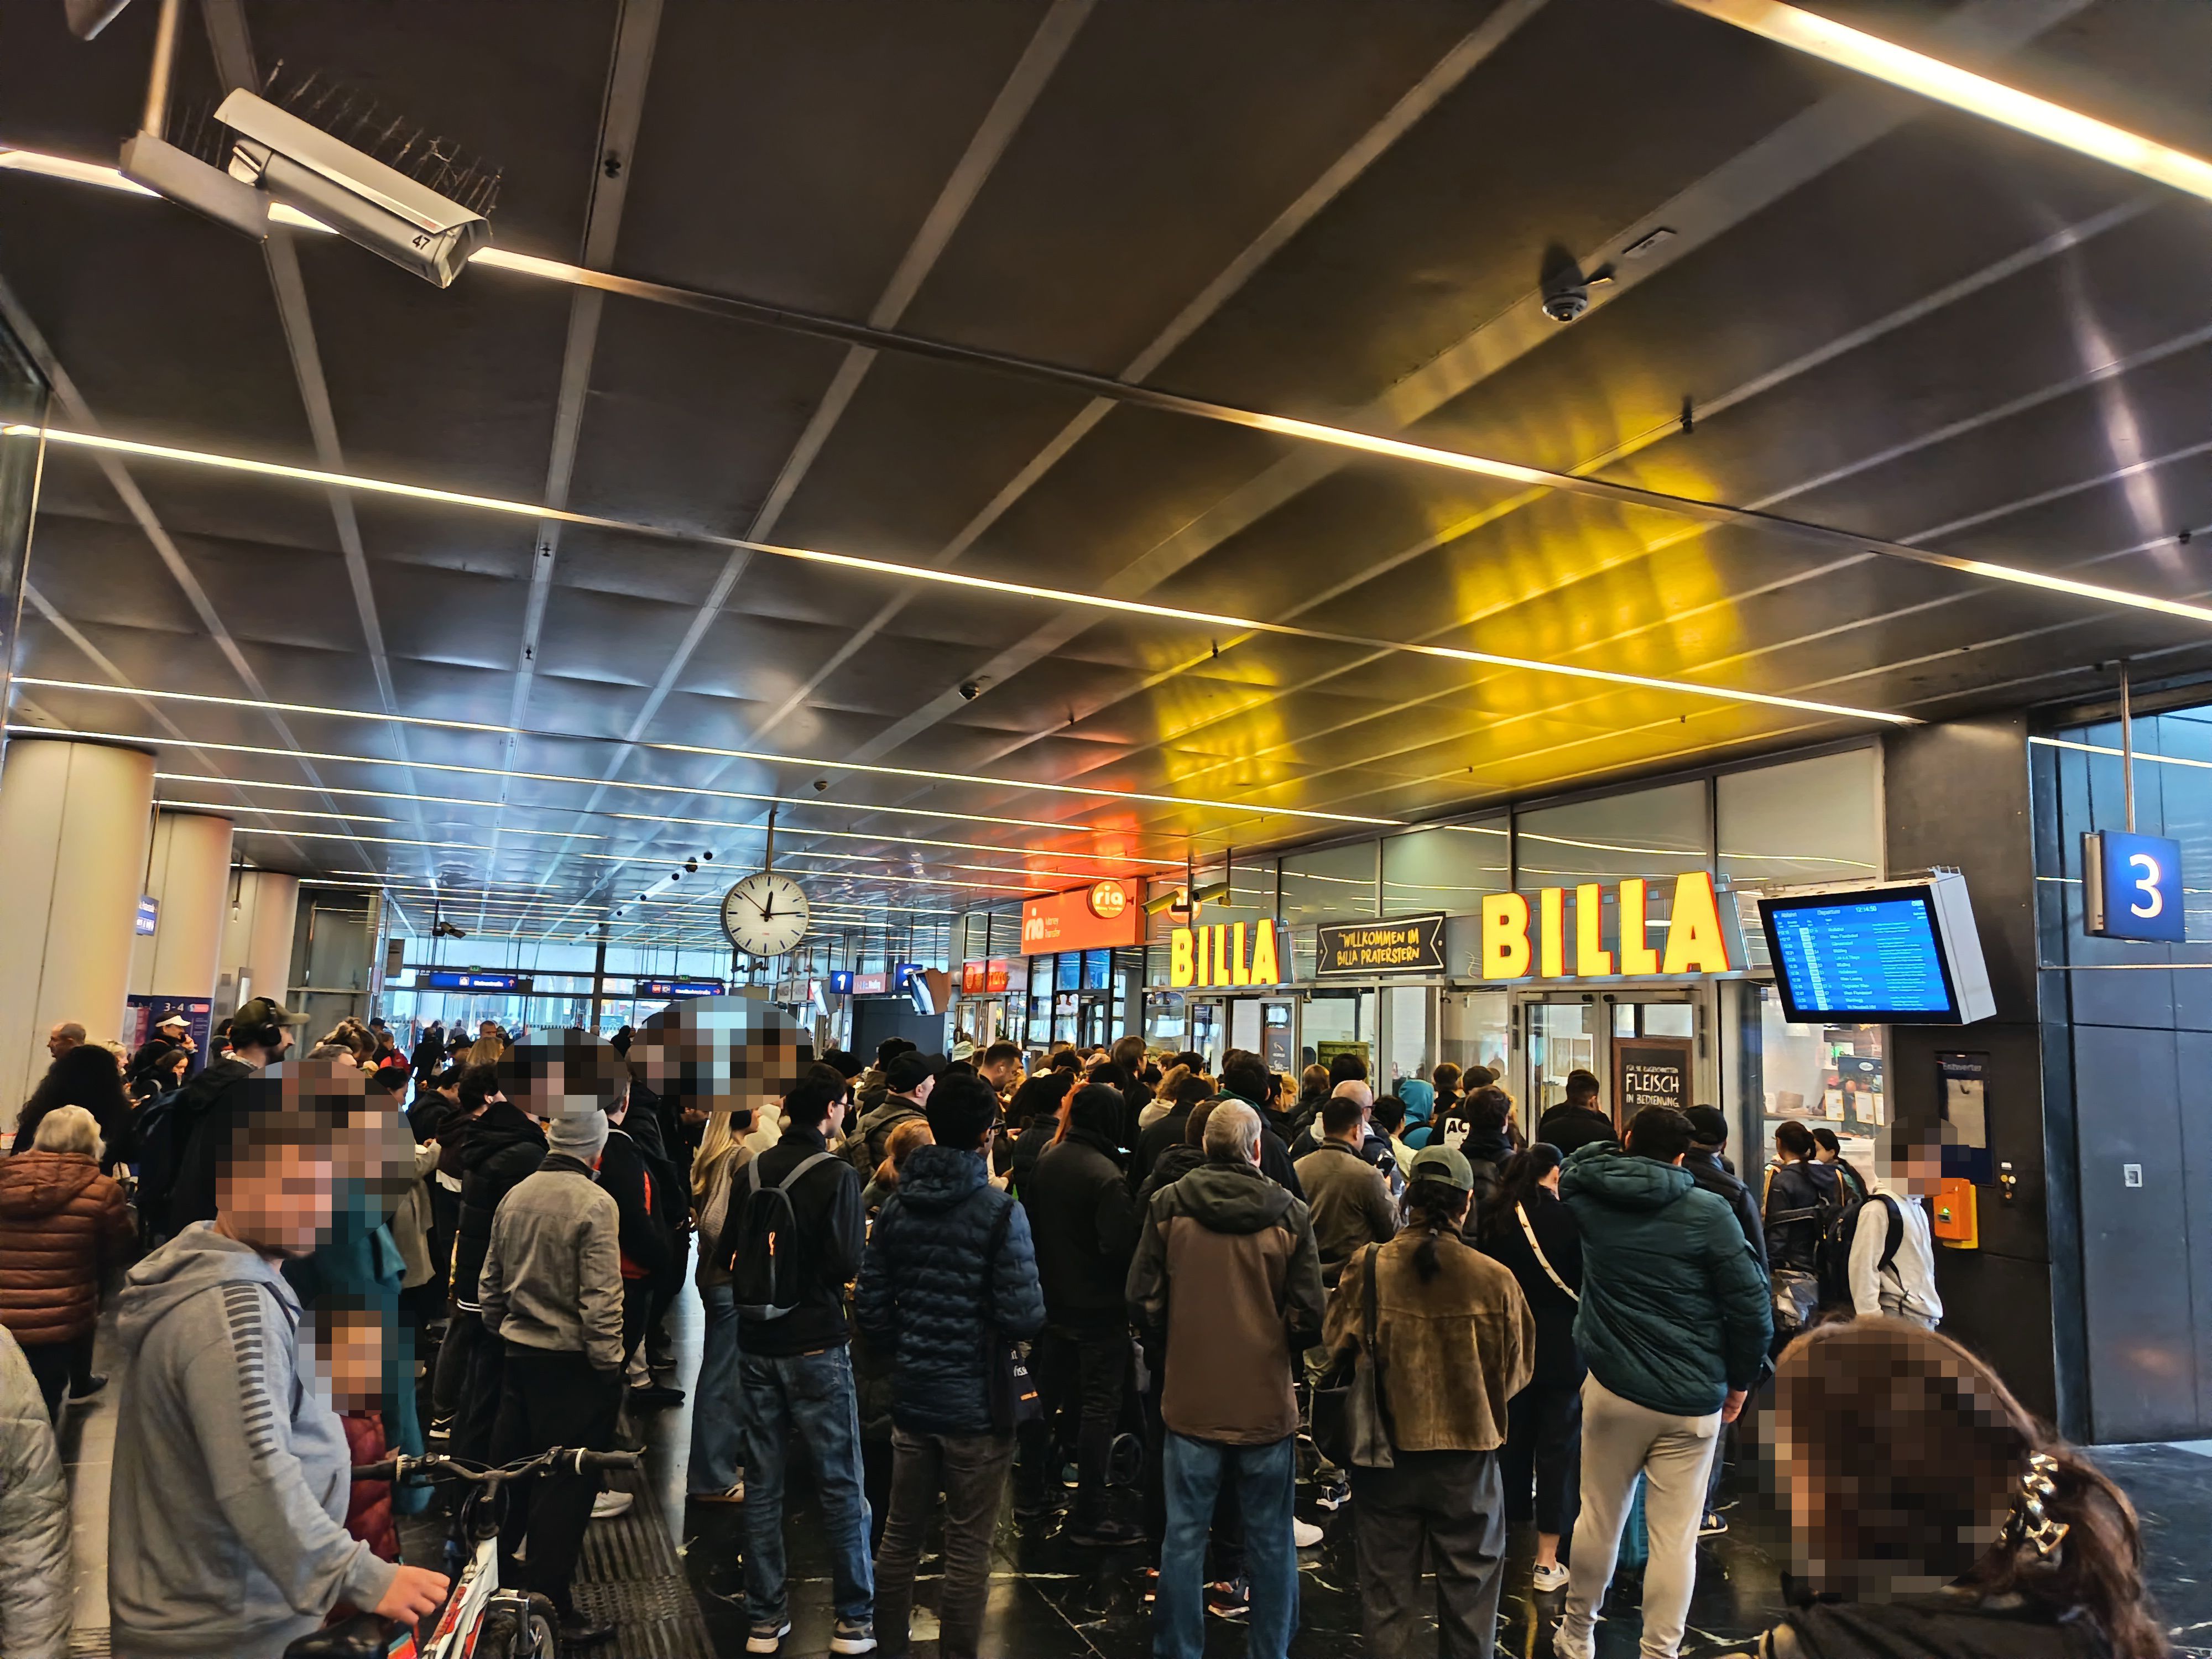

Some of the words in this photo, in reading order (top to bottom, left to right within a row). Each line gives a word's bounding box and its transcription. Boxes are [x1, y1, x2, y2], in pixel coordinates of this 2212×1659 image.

[412, 234, 431, 250] 47
[1095, 885, 1123, 905] ria
[2129, 853, 2163, 919] 3
[1025, 907, 1044, 941] ria
[1481, 871, 1731, 980] BILLA
[1338, 930, 1405, 948] WILLKOMMEN
[1407, 927, 1420, 945] IM
[1171, 917, 1280, 988] BILLA
[1337, 948, 1358, 967] BILLA
[1360, 946, 1420, 966] PRATERSTERN
[837, 974, 847, 991] 1
[1626, 1073, 1680, 1093] FLEISCH
[1626, 1093, 1634, 1104] IN
